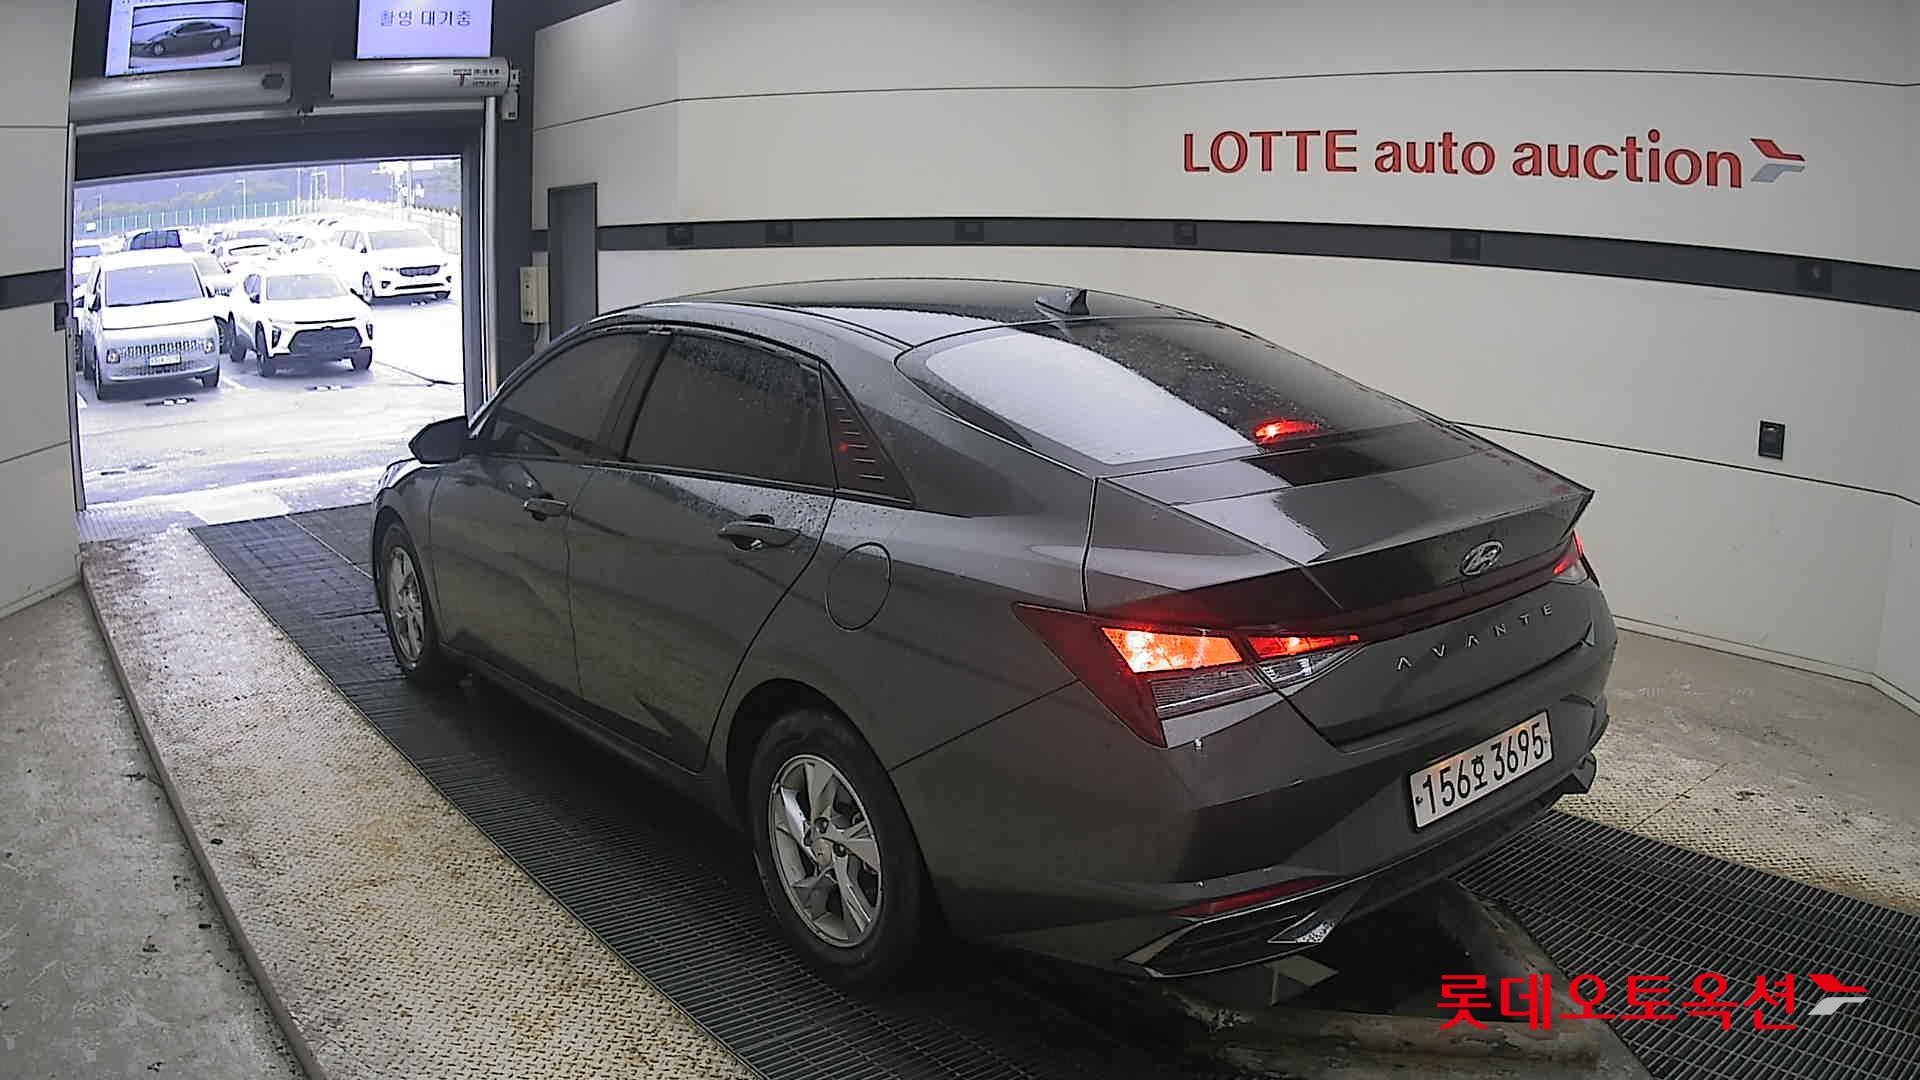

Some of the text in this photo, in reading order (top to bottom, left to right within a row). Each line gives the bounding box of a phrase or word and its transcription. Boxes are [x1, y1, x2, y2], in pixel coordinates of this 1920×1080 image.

[1183, 129, 1745, 189] LOTTE auto auction
[1396, 602, 1553, 671] AVANTE
